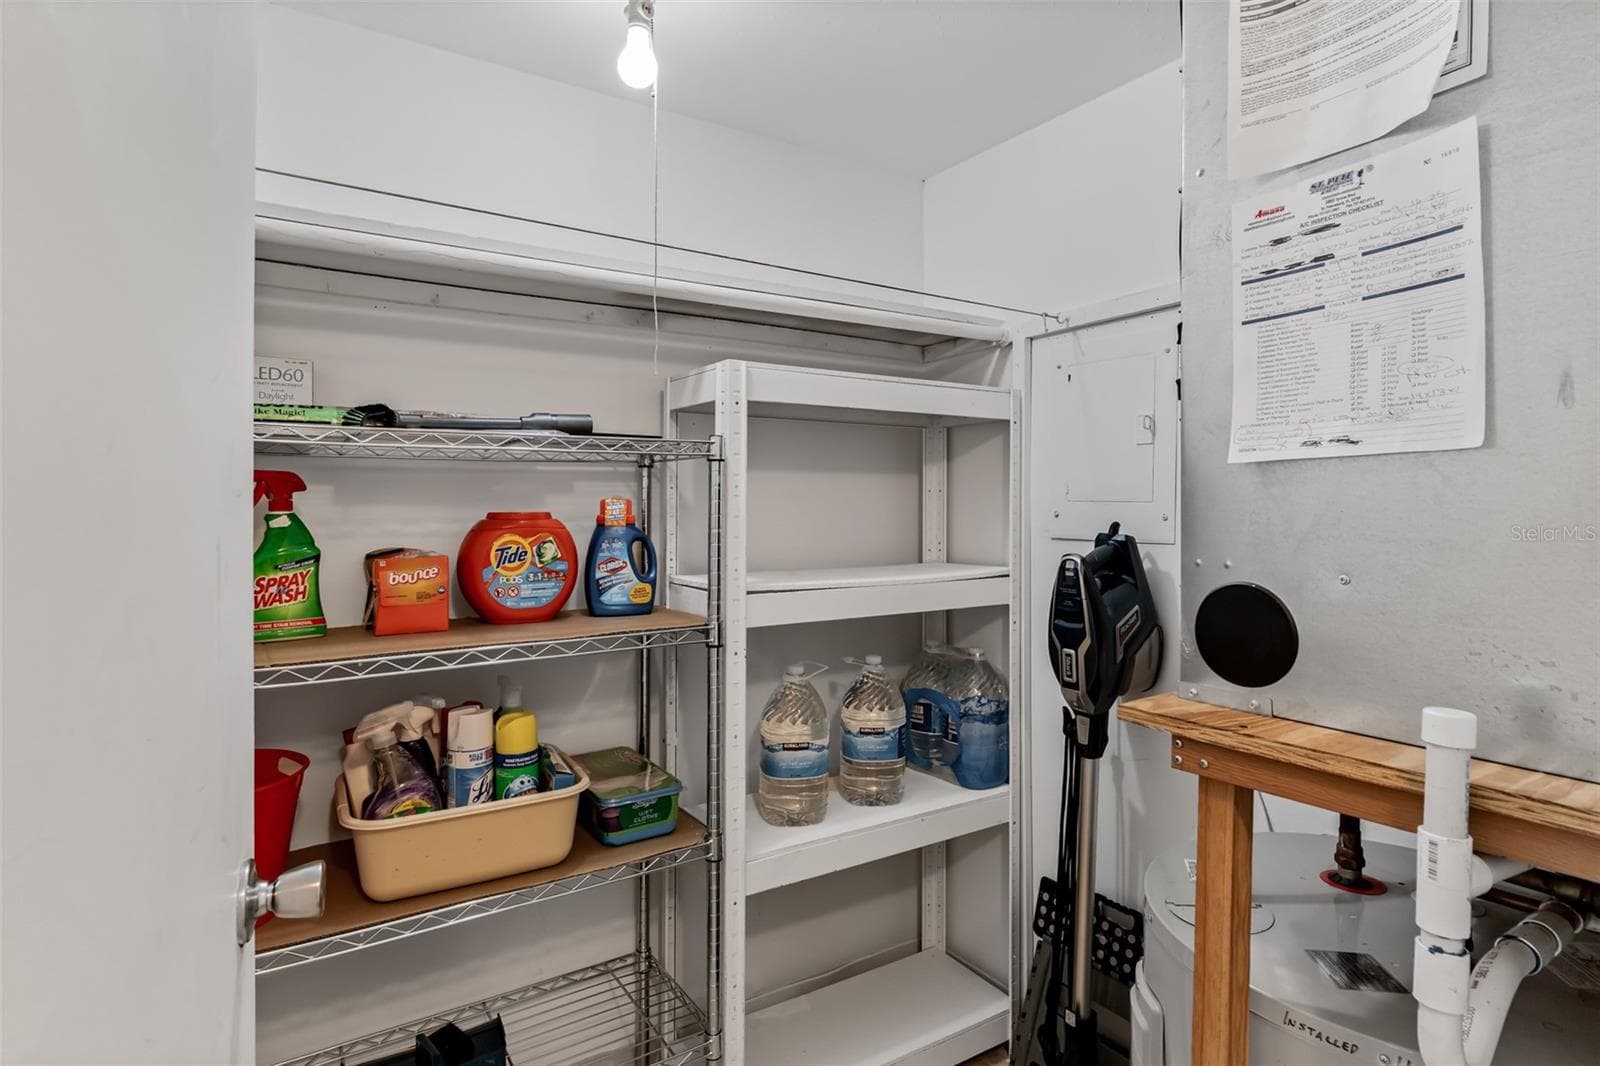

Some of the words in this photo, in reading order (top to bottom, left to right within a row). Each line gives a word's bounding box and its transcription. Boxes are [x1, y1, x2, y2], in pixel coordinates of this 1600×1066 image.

[1311, 211, 1347, 226] INSPECTION
[1349, 200, 1384, 215] CHECKLIST
[258, 391, 295, 402] Daylight
[273, 408, 306, 417] Magic!
[494, 545, 528, 569] Tide
[254, 569, 313, 594] SPRAY
[388, 567, 440, 585] bounce
[500, 576, 524, 584] PODS
[254, 585, 308, 609] WASH
[1283, 1010, 1359, 1054] INSTALLED
